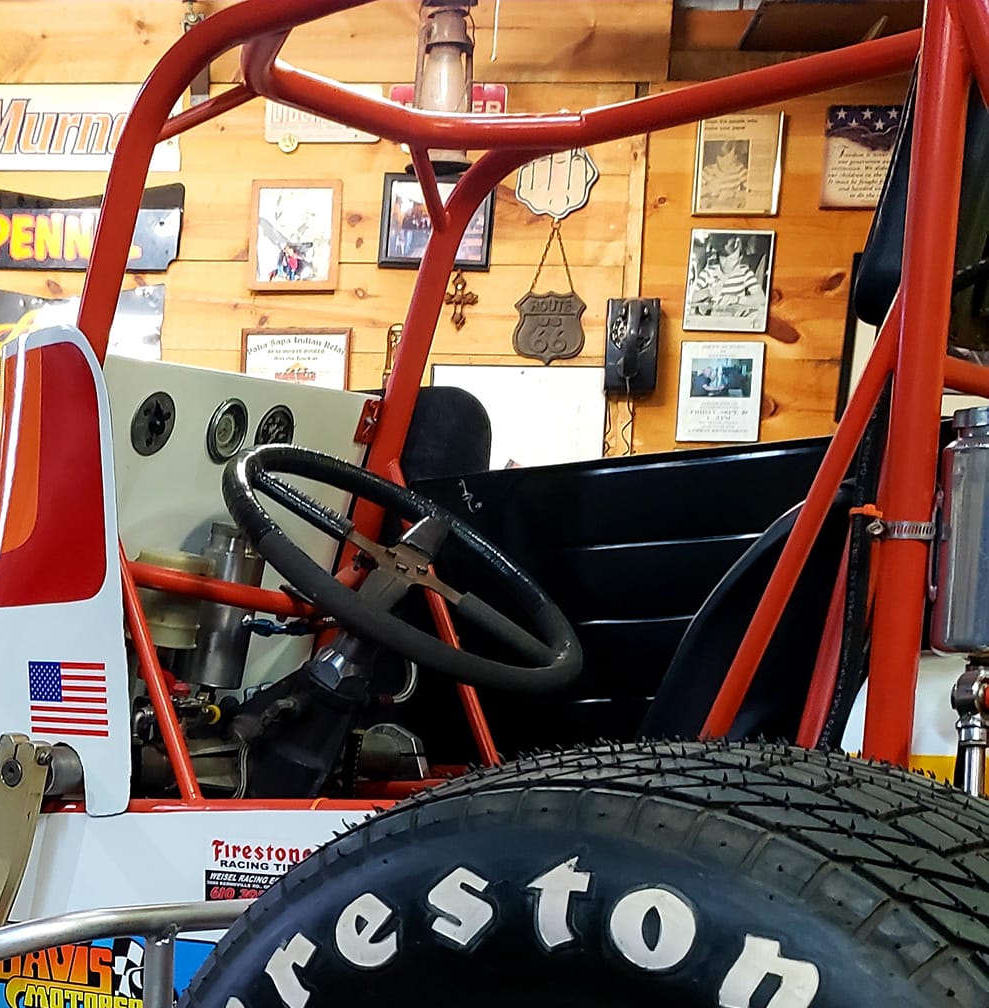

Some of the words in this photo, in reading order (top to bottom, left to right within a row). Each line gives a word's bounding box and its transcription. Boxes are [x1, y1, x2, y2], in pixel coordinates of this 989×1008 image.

[529, 300, 574, 313] ROUTE
[293, 336, 322, 348] Indian
[529, 329, 568, 355] 66
[220, 860, 270, 871] RACING
[209, 872, 237, 882] WEISEL
[238, 875, 269, 884] RACING
[210, 886, 236, 899] 610
